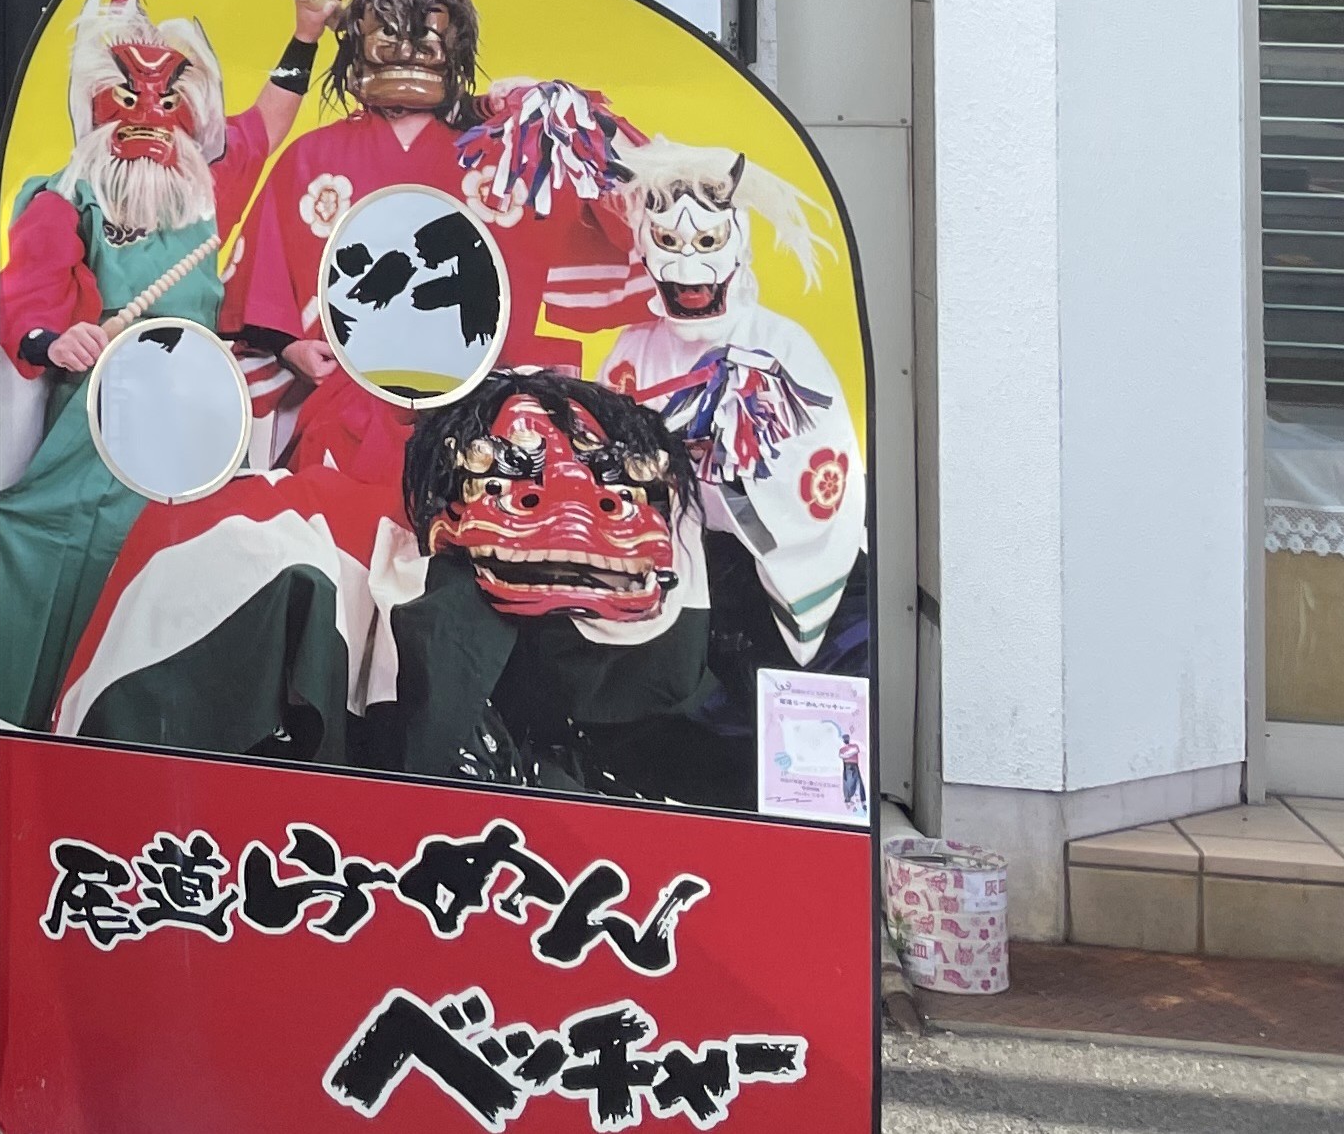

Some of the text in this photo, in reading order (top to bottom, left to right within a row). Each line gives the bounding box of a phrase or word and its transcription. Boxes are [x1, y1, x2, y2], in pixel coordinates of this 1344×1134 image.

[40, 819, 710, 977] 尾道らーめん
[323, 986, 808, 1134] ベッチャー
